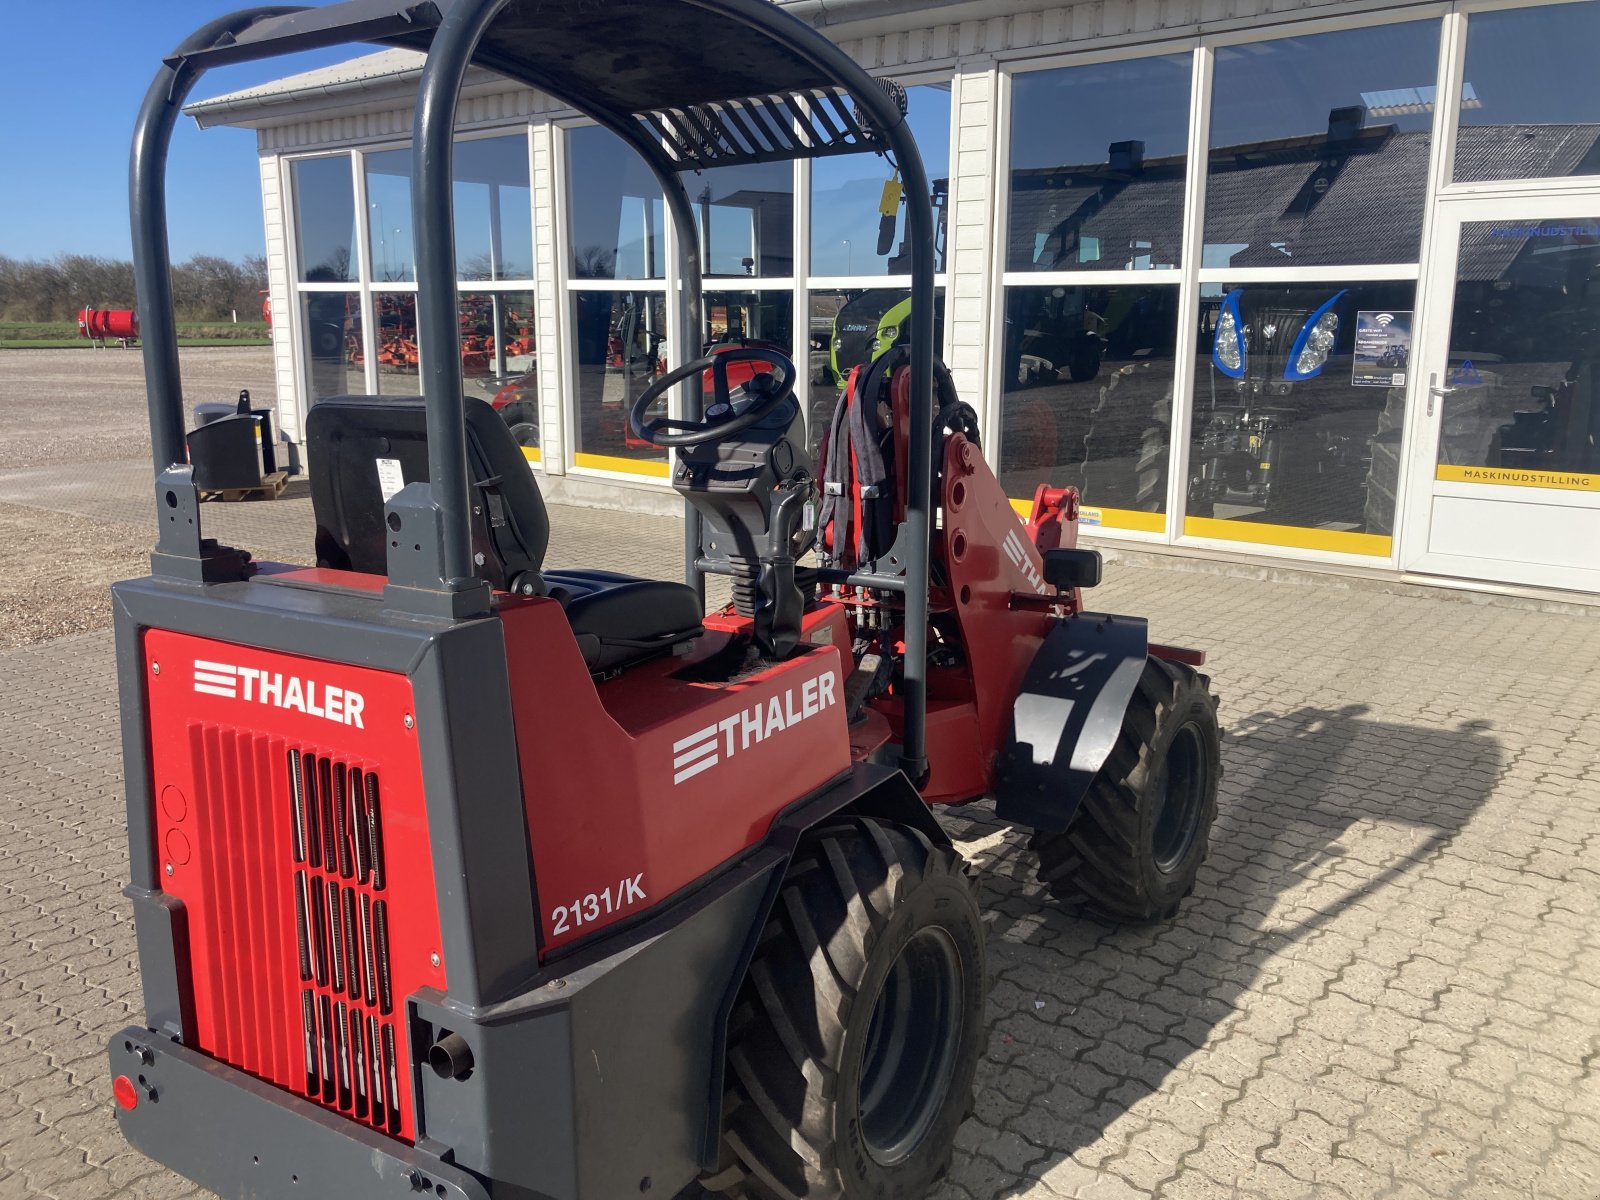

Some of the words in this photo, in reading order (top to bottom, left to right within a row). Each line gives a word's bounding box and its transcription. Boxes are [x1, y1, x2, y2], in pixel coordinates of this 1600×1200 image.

[1464, 470, 1590, 486] MASKINUDSTILLING
[237, 666, 365, 729] THALER
[719, 670, 836, 758] THALER
[551, 873, 647, 936] 2131/K
